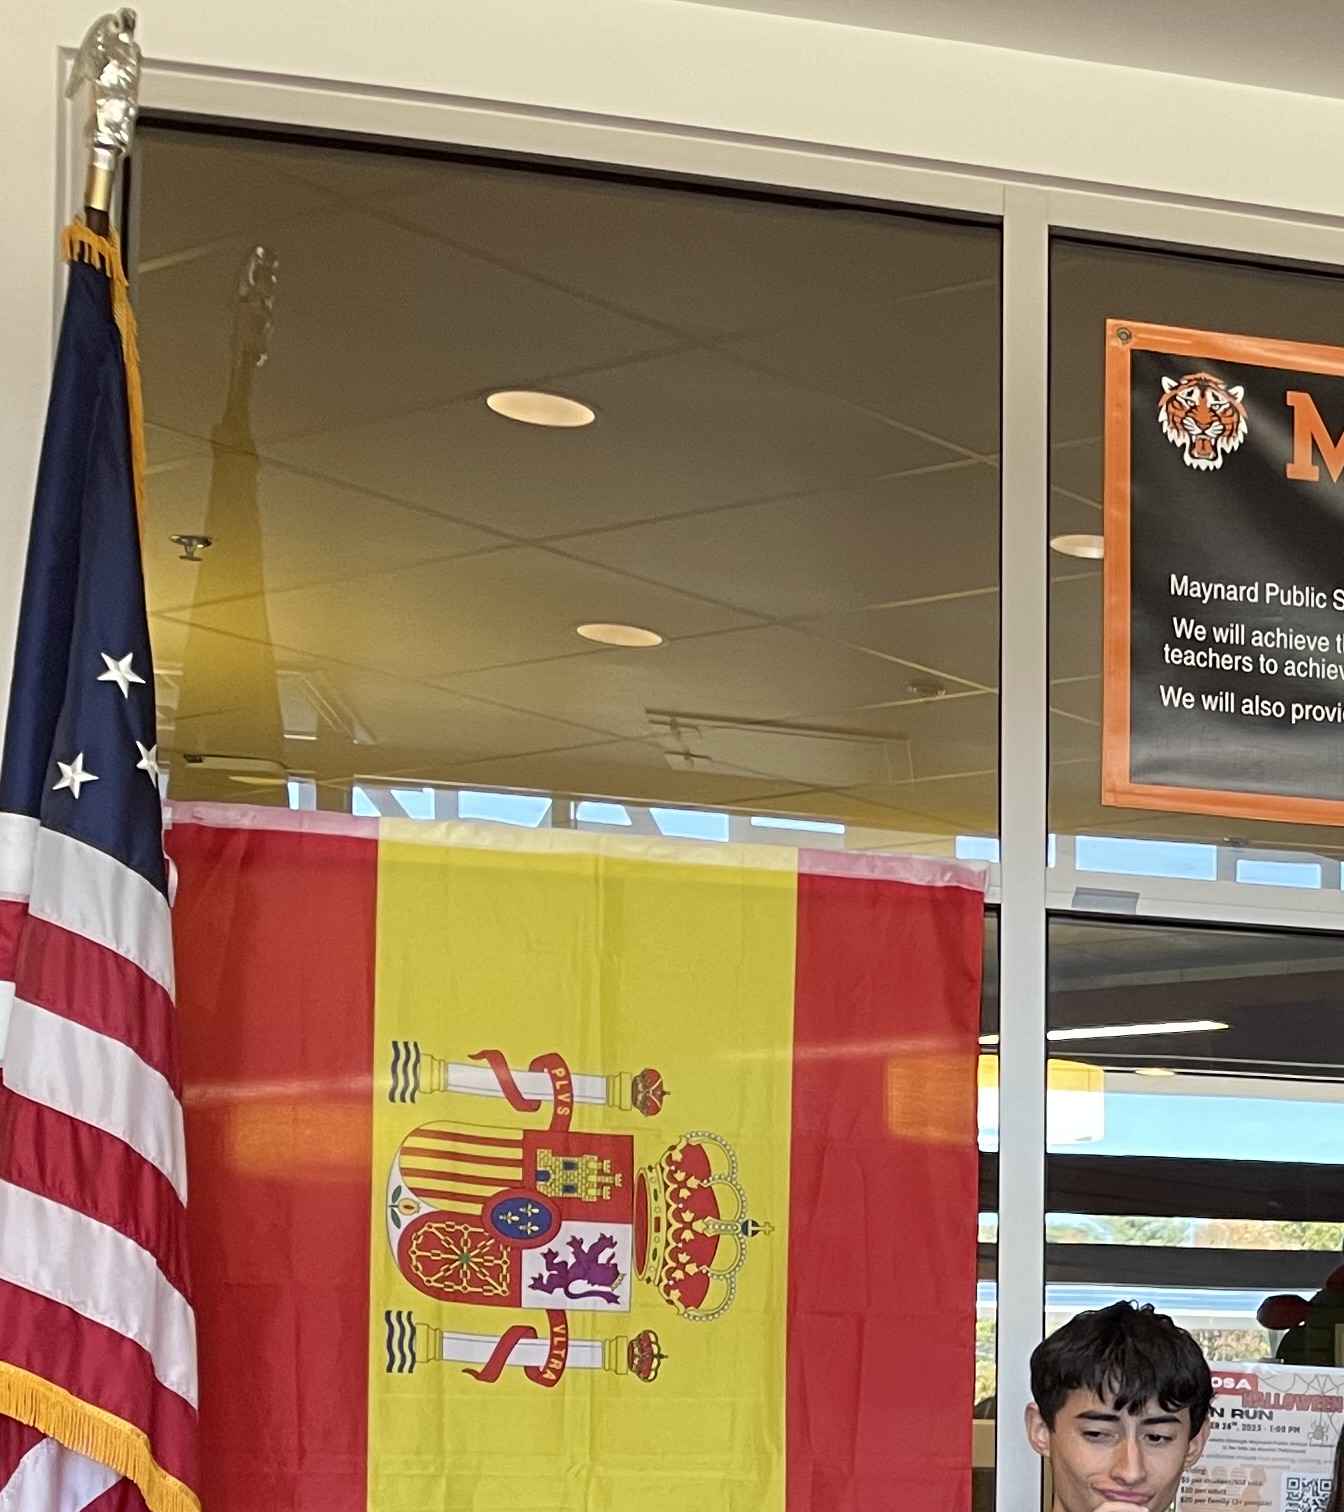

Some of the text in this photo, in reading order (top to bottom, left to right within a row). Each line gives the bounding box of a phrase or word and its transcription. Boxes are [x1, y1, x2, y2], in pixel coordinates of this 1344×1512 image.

[1170, 574, 1258, 602] Maynard
[1265, 583, 1326, 608] Public
[1173, 616, 1206, 638] We
[1212, 621, 1244, 642] will
[1251, 626, 1329, 650] achieve
[1160, 684, 1194, 707] We
[1201, 690, 1234, 711] will
[1241, 694, 1284, 716] also
[551, 1067, 571, 1115] PLVS
[542, 1324, 567, 1380] VLTRA
[1211, 1376, 1252, 1389] OSA
[1231, 1409, 1274, 1420] RUN
[1241, 1390, 1344, 1413] HALLOWEEN
